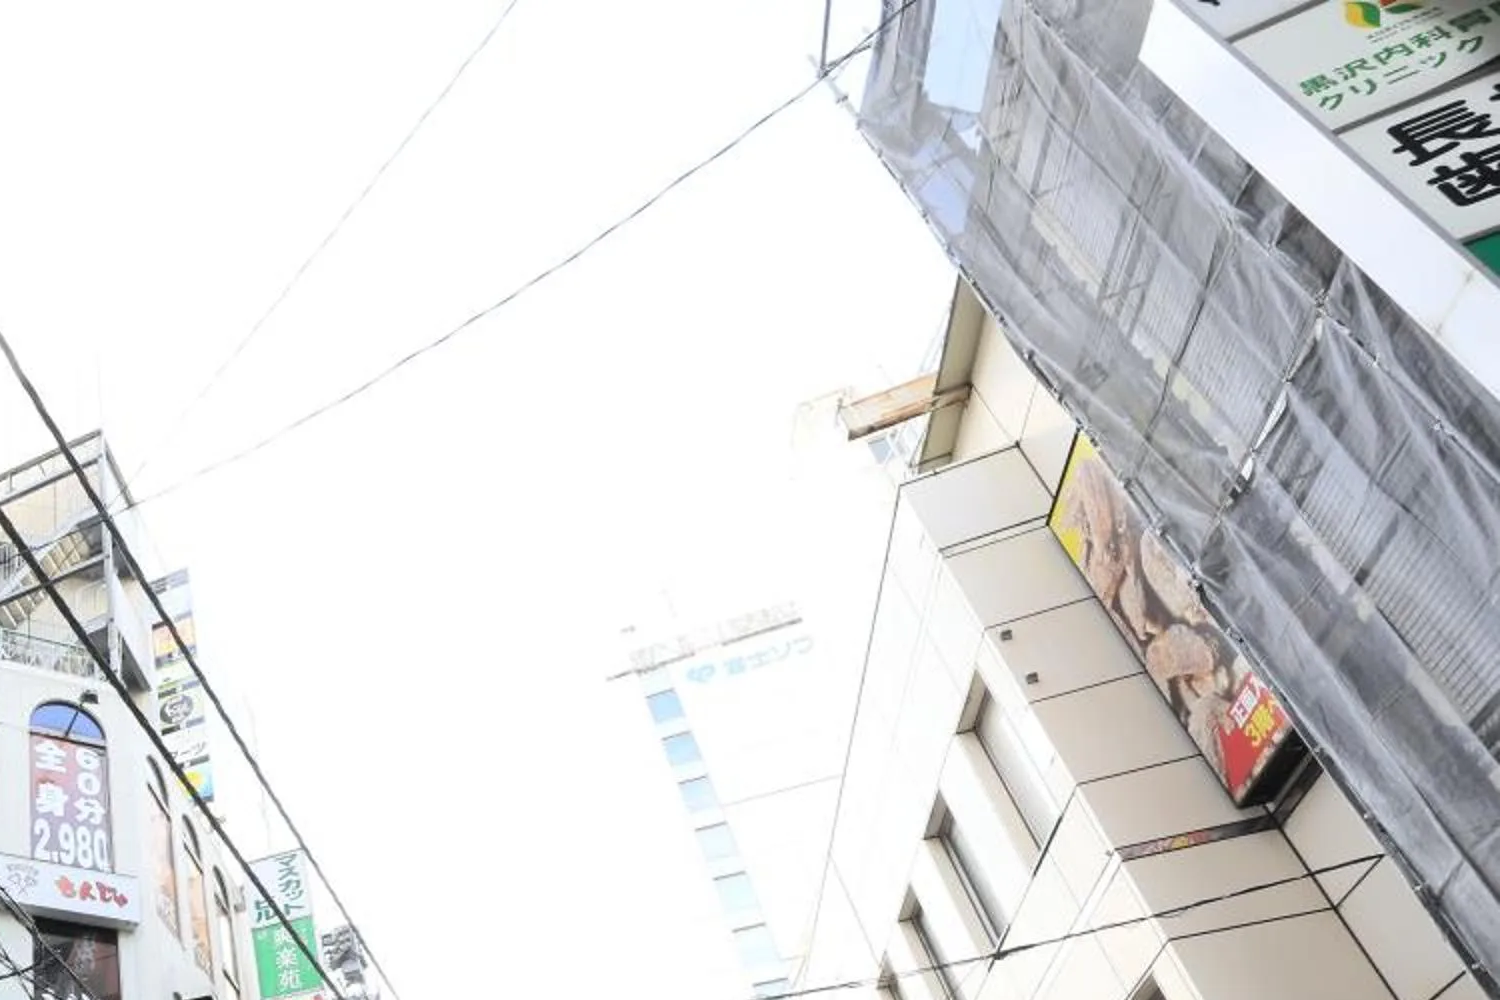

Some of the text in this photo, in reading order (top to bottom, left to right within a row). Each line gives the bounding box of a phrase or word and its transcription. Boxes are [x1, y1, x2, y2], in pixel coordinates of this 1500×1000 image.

[1318, 36, 1484, 111] クリニック
[1387, 82, 1500, 166] 長
[34, 739, 68, 819] 全身
[75, 749, 107, 826] 60分
